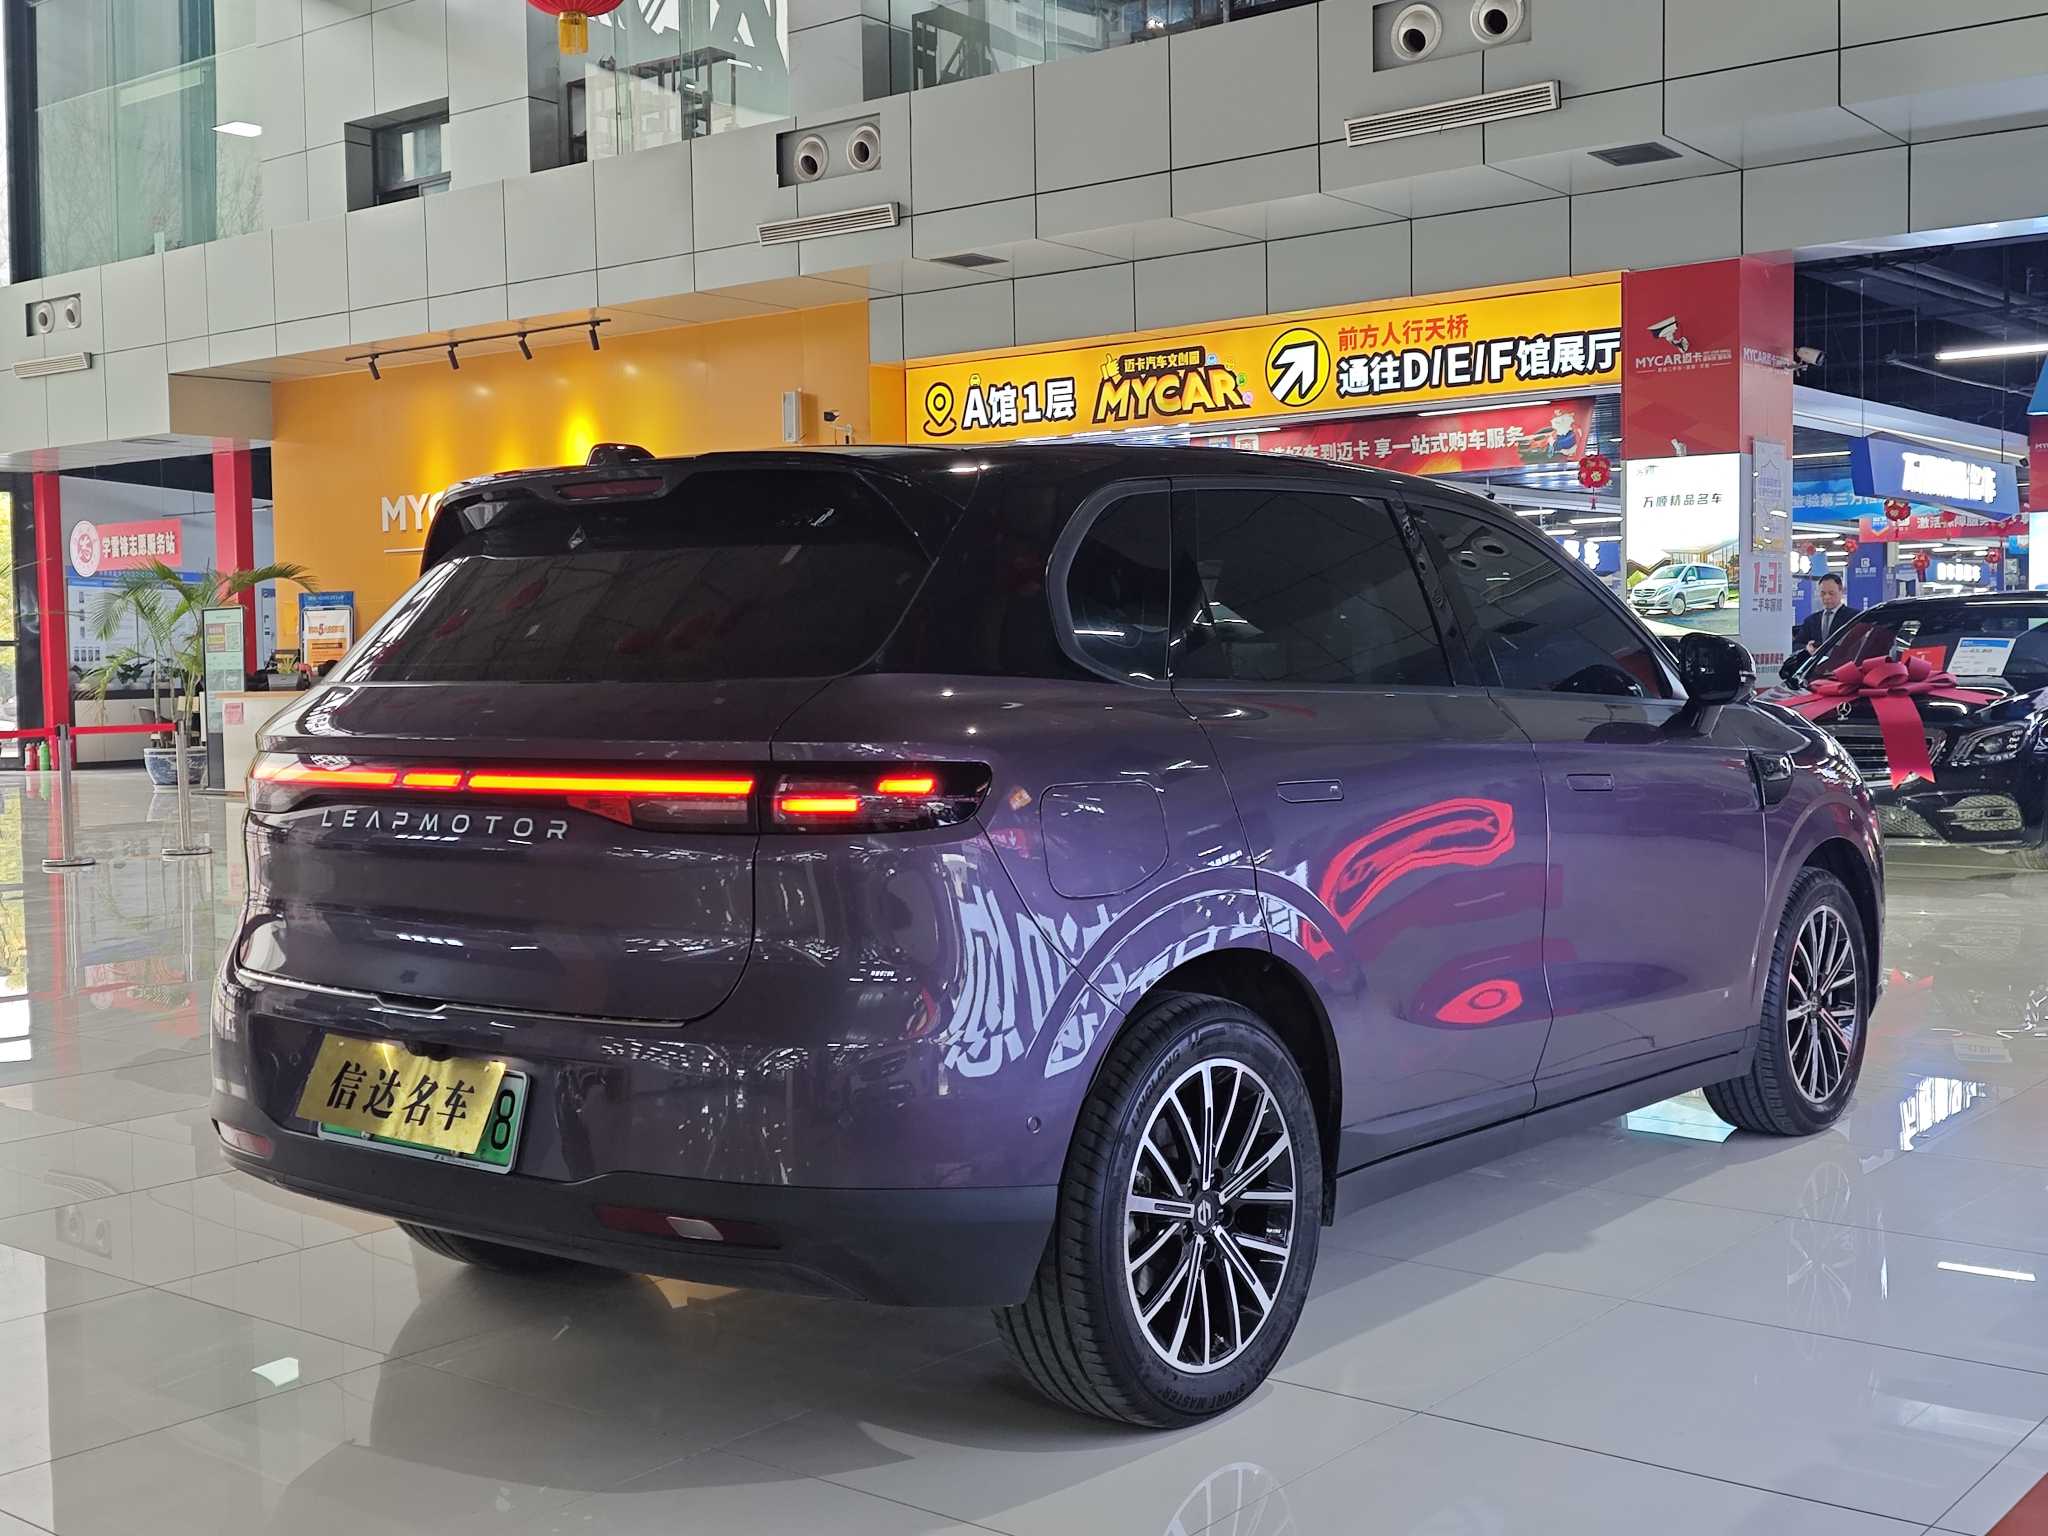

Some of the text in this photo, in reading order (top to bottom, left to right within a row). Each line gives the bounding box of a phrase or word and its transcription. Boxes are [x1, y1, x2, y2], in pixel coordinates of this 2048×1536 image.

[1338, 314, 1468, 351] 前方人行天桥
[1338, 331, 1621, 395] 通往D/E/F馆展厅
[962, 379, 1076, 429] A馆1层
[1094, 370, 1246, 424] MYCAR
[1374, 426, 1524, 459] 享一站式购车服务
[102, 531, 175, 558] 学雷锋志愿服务站
[321, 809, 568, 839] LEAPMOTOR
[326, 1060, 475, 1131] 信达名车
[1132, 1049, 1181, 1129] LINGLONG
[490, 1089, 516, 1150] 8
